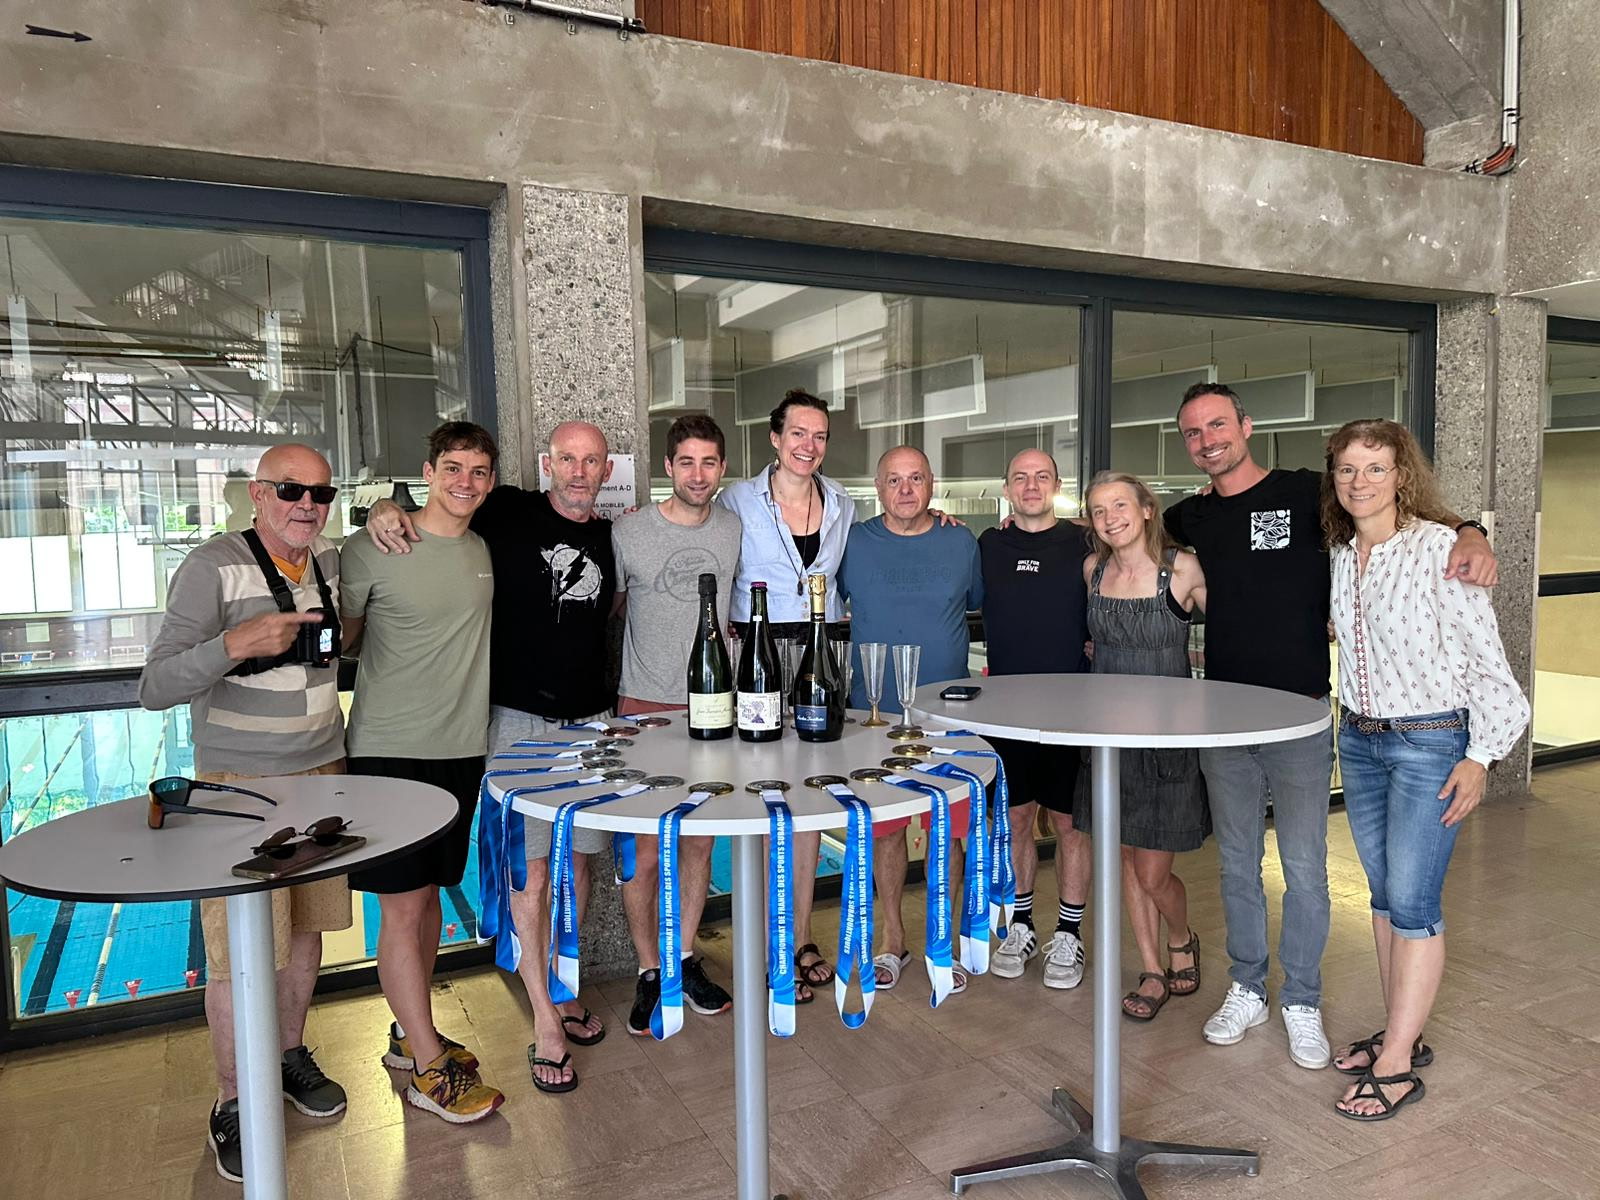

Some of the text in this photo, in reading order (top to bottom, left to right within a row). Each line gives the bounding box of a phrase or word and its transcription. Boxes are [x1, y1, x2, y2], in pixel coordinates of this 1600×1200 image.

[777, 846, 785, 873] SPORTS
[860, 906, 867, 915] DE
[666, 918, 673, 927] DE
[778, 915, 785, 924] DE
[666, 928, 674, 978] CHAMPIONNAT
